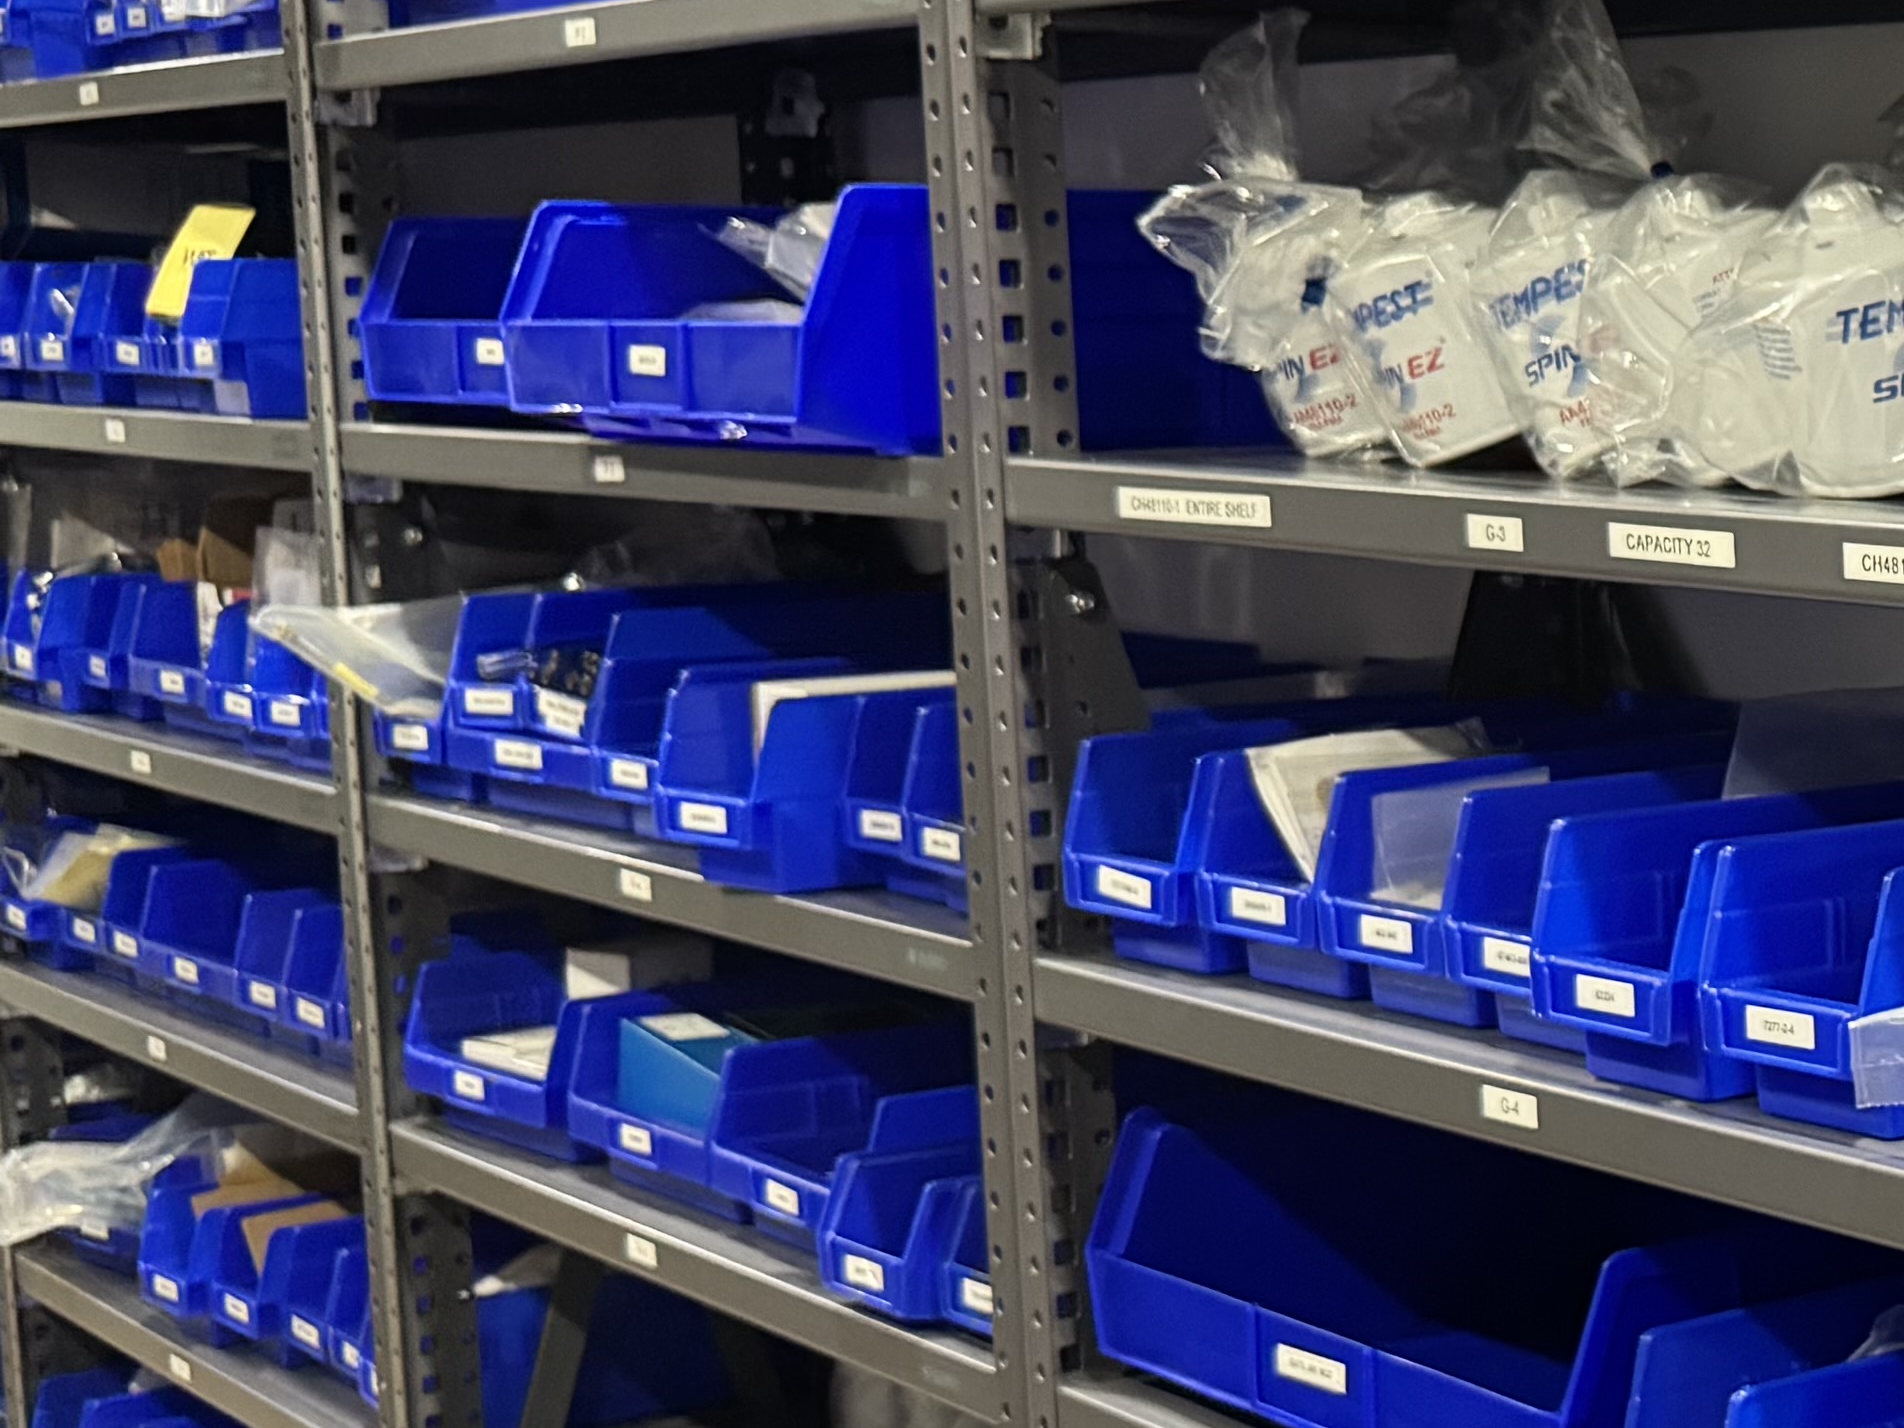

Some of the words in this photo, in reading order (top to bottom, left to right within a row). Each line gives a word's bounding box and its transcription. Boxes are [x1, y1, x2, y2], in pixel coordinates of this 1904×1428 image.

[1185, 499, 1222, 517] ENTIRE
[1224, 502, 1257, 519] SHELF
[1486, 524, 1507, 542] G-3
[1625, 533, 1693, 556] CAPACITY
[1697, 538, 1711, 558] 32
[1501, 1098, 1520, 1116] G-4
